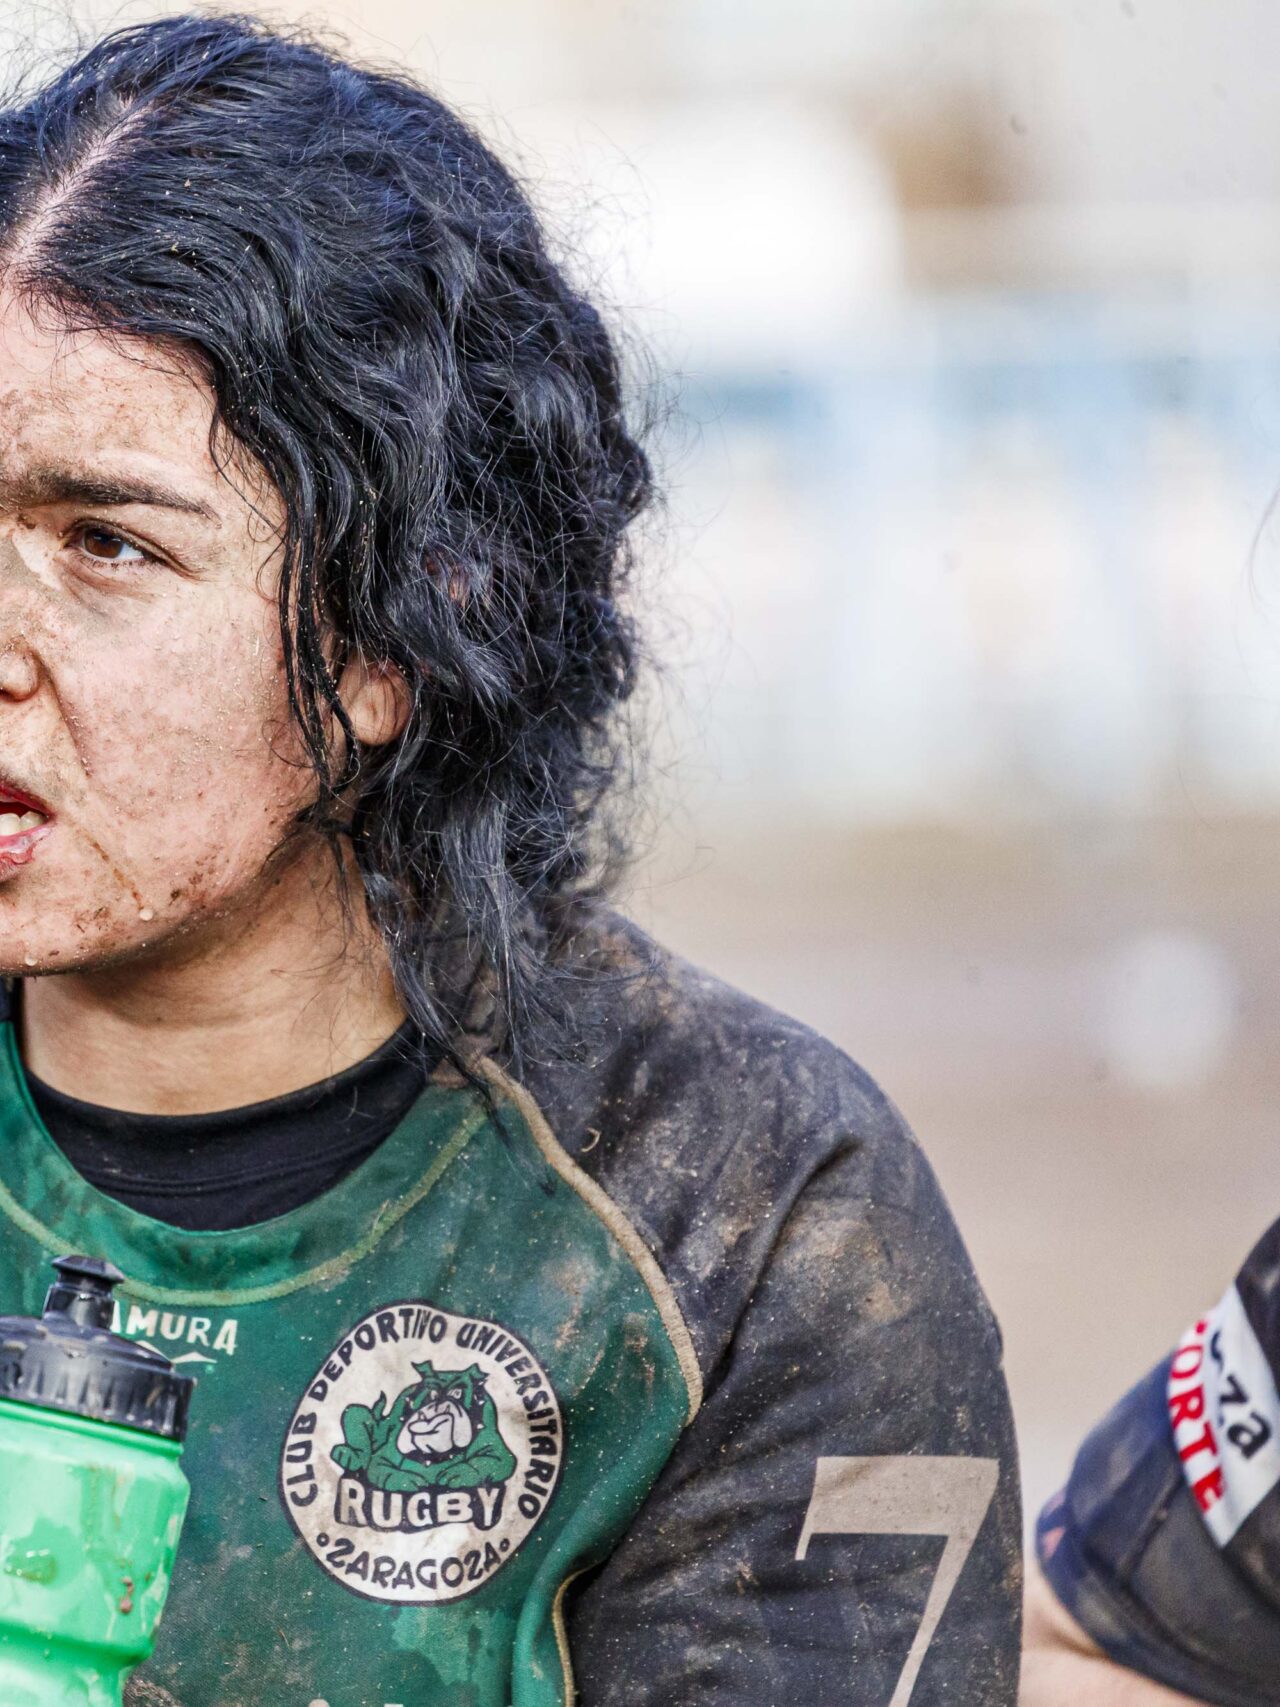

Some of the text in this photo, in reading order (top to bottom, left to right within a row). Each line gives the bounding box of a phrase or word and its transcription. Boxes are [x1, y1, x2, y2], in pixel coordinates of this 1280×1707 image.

[286, 1308, 559, 1520] CLUB DEPORTIVO UNIVERSITARIO
[326, 1537, 502, 1590] ZARAGOZA
[338, 1477, 501, 1527] RUGBY
[794, 1455, 1000, 1707] 7
